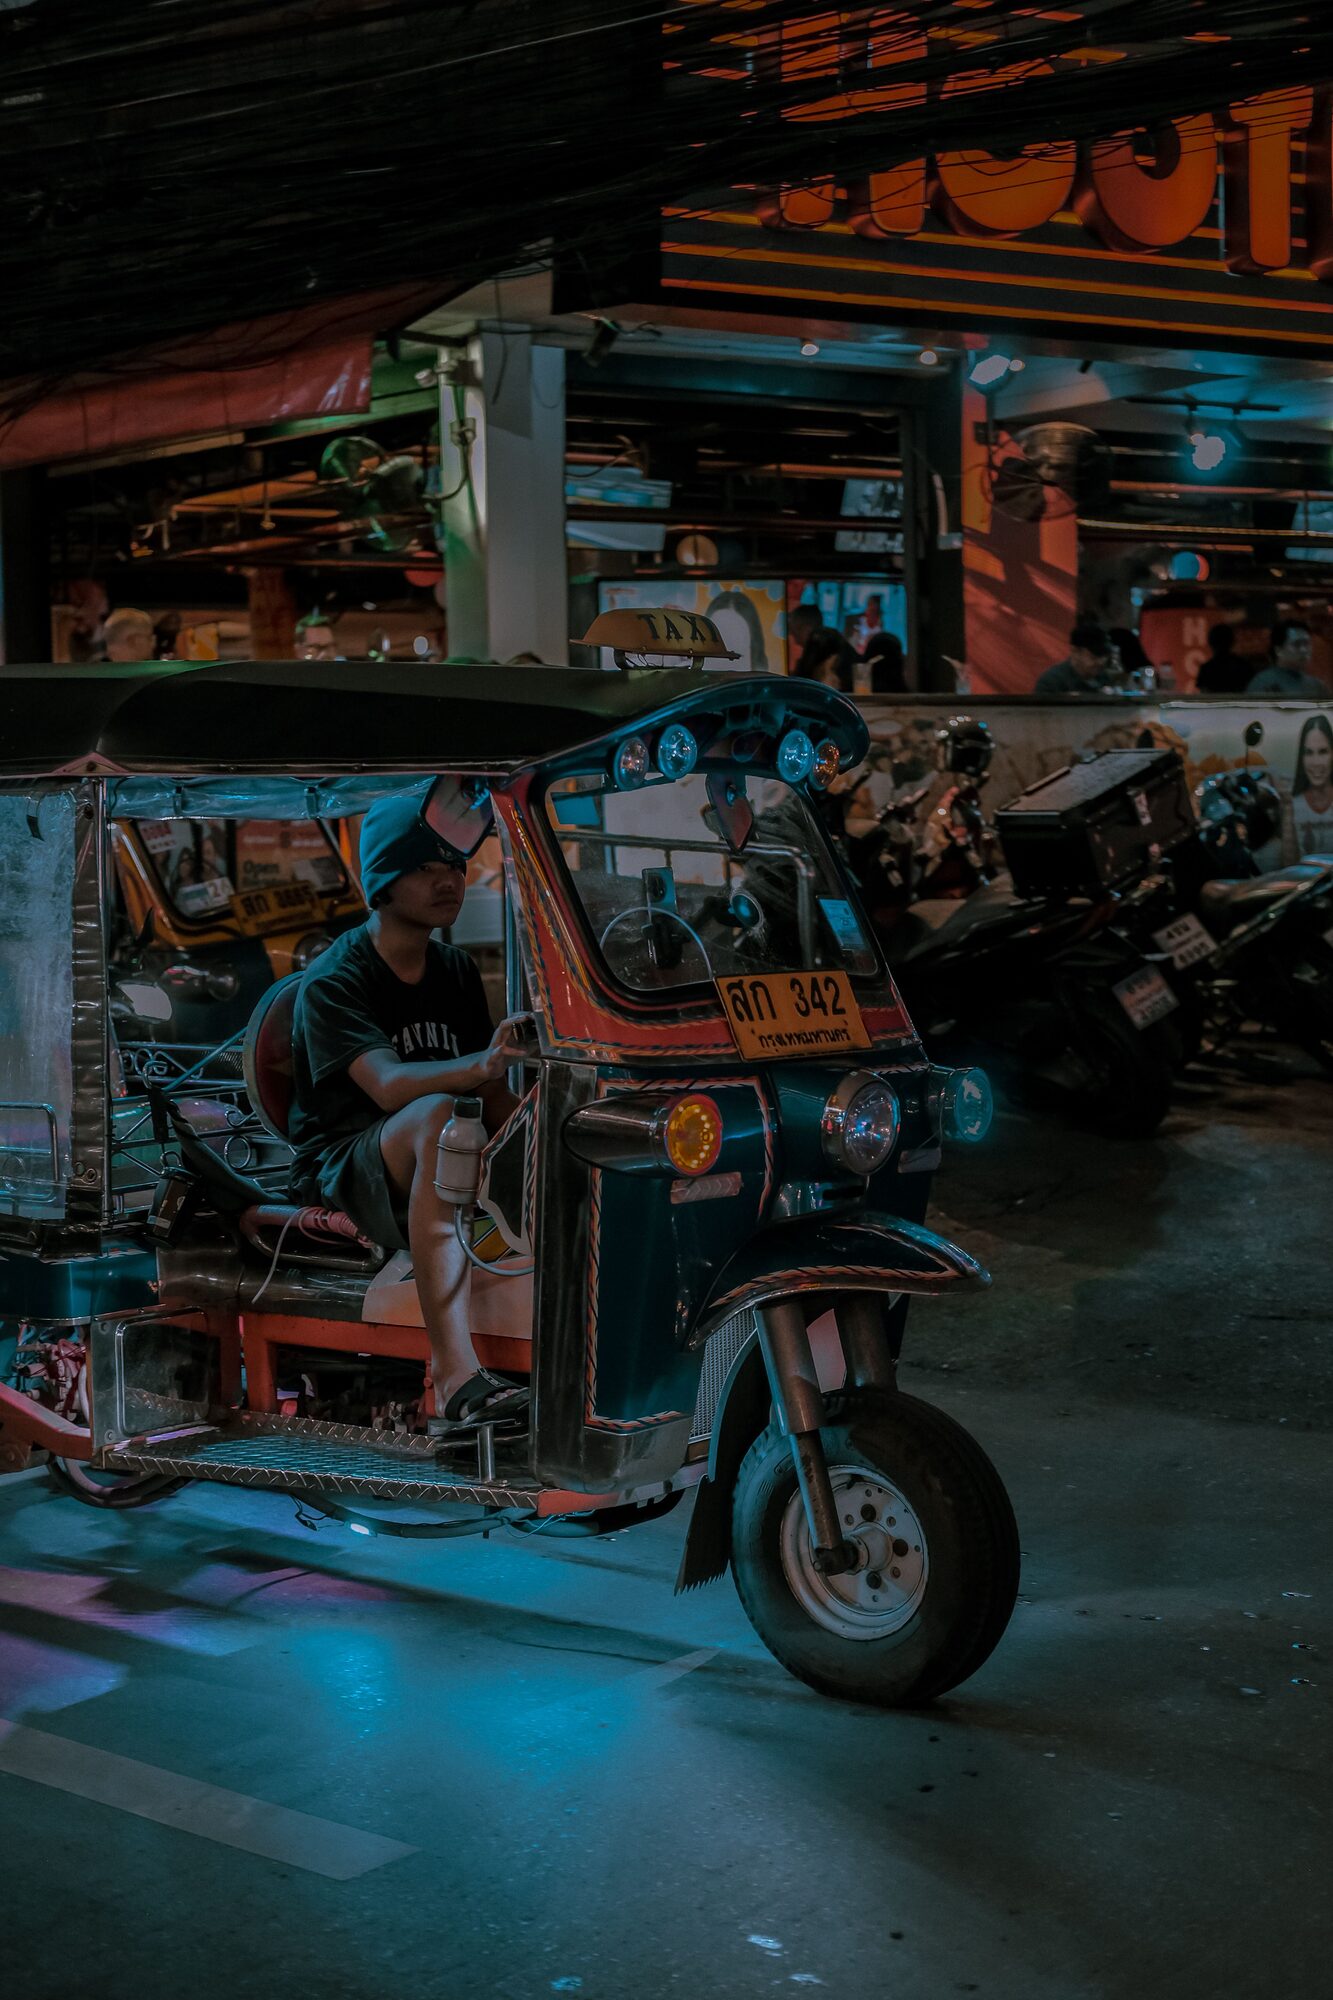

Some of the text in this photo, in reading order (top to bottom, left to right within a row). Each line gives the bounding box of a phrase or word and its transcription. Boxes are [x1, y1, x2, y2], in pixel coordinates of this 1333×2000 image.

[637, 613, 719, 643] TAXI
[727, 976, 846, 1022] สก 342
[758, 1028, 851, 1052] กรุงเทพมหานคร
